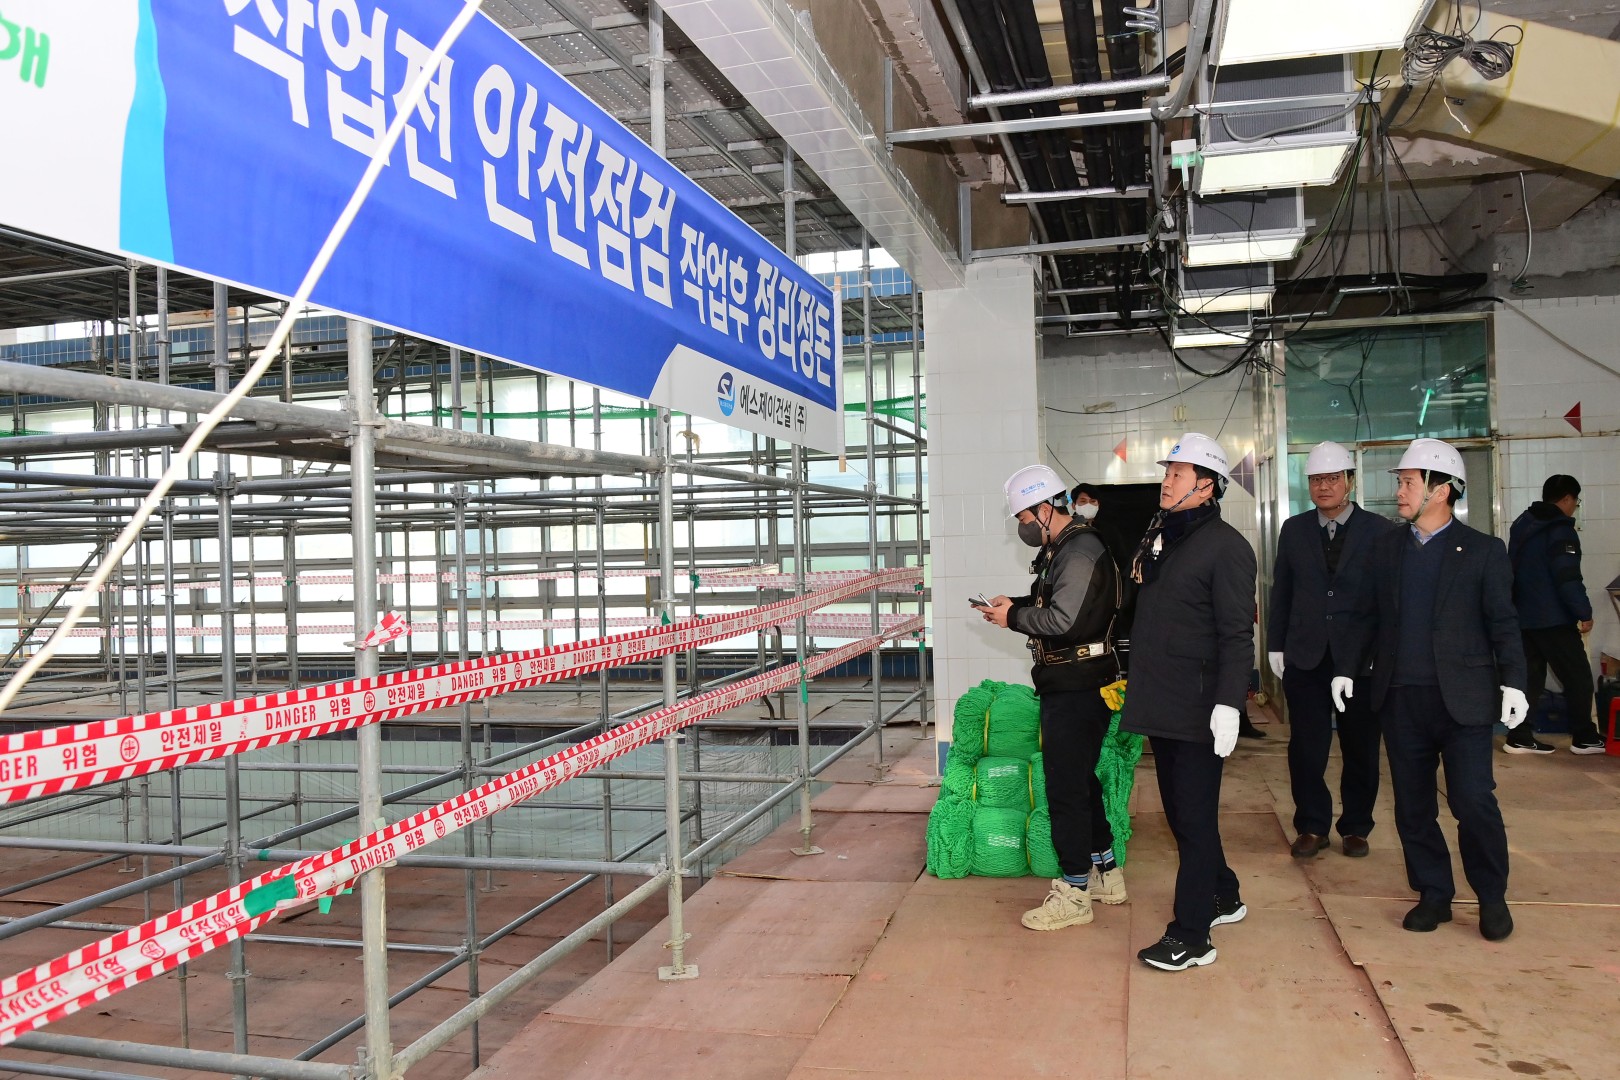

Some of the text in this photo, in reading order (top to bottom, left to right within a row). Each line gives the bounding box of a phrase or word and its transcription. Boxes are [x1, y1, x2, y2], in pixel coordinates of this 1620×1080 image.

[223, 0, 832, 388] 작업전 안전점검 작업후 정리정돈
[740, 385, 808, 434] 에스제이건설 (주)
[0, 754, 38, 782] GER
[62, 744, 98, 771] 위험
[160, 721, 223, 753] 안전제일
[265, 701, 317, 731] DANGER
[330, 697, 351, 719] 위험
[387, 683, 426, 706] 안전제일
[451, 670, 484, 692] DANGER
[492, 667, 507, 683] 위험
[529, 657, 556, 678] 안전제일
[573, 649, 596, 664] DANGER
[0, 980, 69, 1022] ANGER
[84, 955, 126, 984] 위험
[180, 904, 244, 943] 안전제일
[350, 843, 397, 875] DANGER
[404, 828, 426, 850] 위험
[454, 800, 489, 828] 안전제일
[508, 776, 540, 801] DANGER
